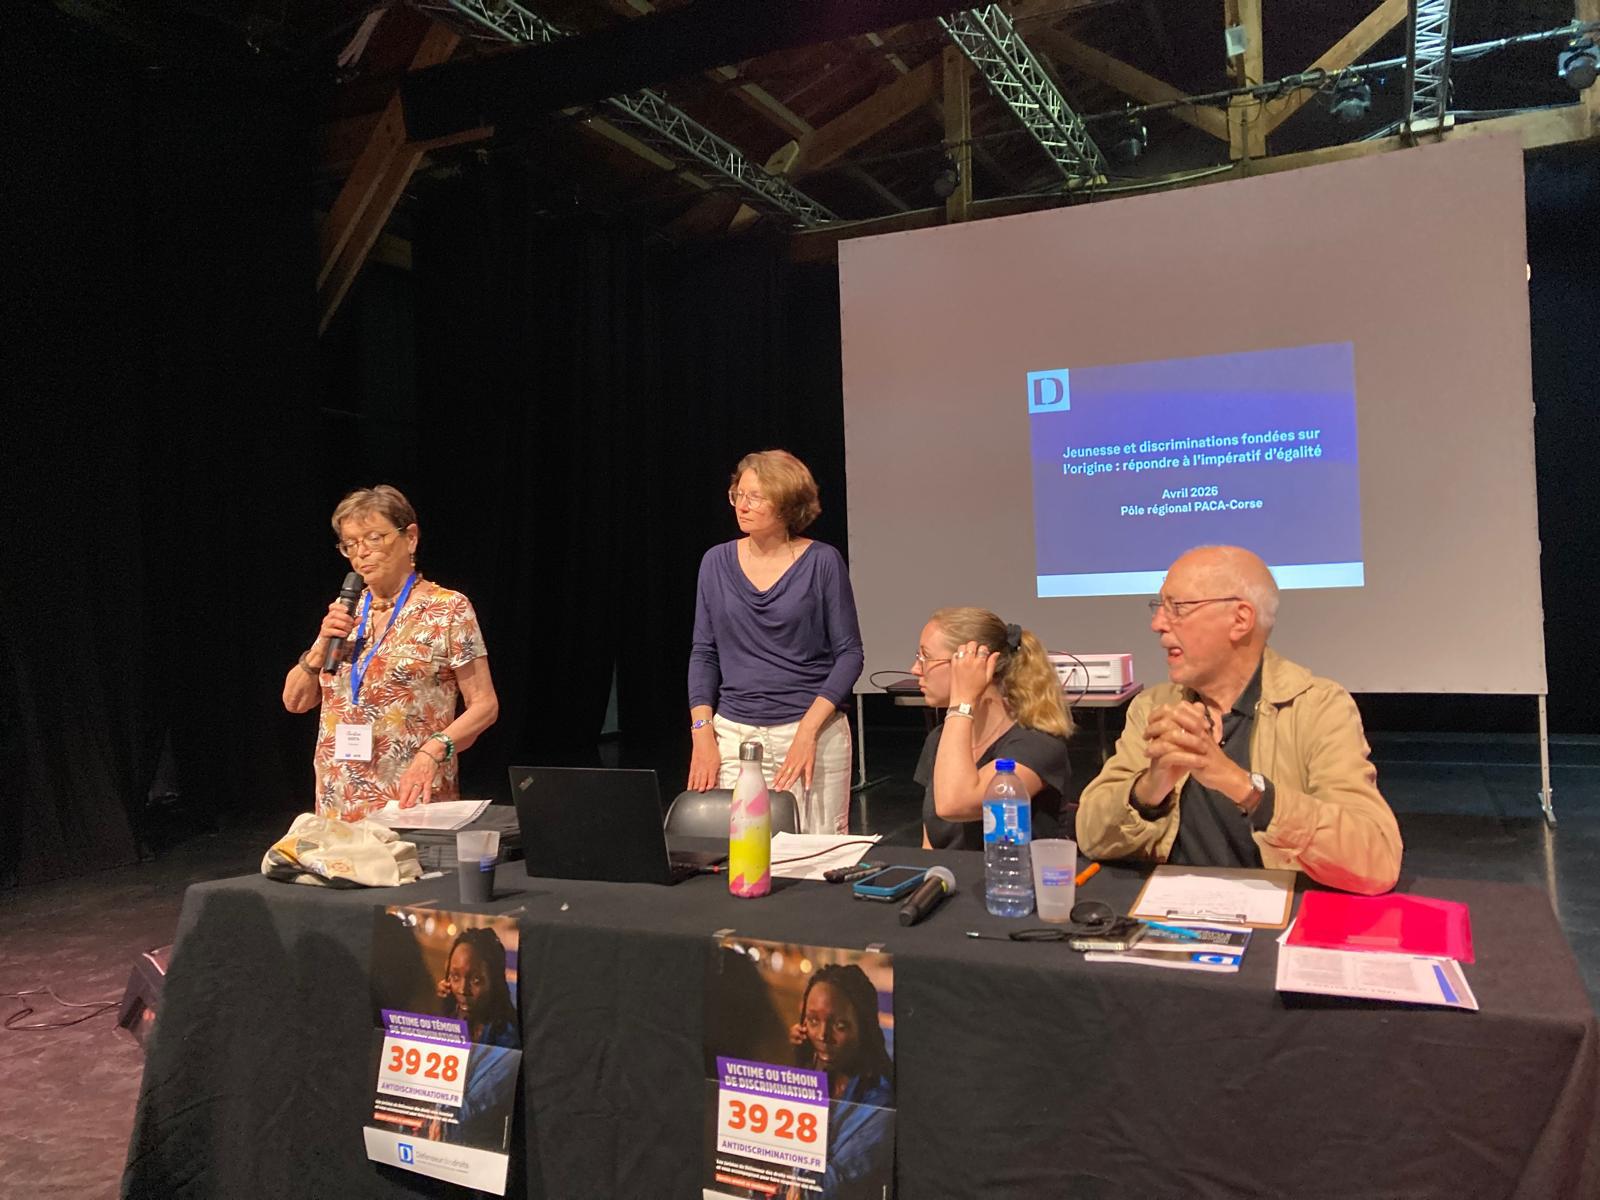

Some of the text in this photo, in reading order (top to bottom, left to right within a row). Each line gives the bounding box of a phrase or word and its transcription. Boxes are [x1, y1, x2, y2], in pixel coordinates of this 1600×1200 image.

[1033, 377, 1064, 406] D
[1063, 430, 1321, 458] Jeunesse et discriminations fondées sur
[1122, 457, 1180, 472] répondre
[1182, 455, 1190, 466] à
[1193, 449, 1262, 467] l'impératif
[1162, 486, 1218, 499] Avril 2026
[1120, 499, 1263, 516] Pôle régional PACA-Corse
[388, 1014, 420, 1027] VICTIME
[431, 1019, 461, 1034] TÉMOIN
[388, 1046, 459, 1082] 39 28
[726, 1063, 818, 1088] VICTIME OU TÉMOIN
[381, 1082, 460, 1103] ANTIDISCRIMINATIONS.FR
[725, 1075, 737, 1087] DE
[738, 1077, 817, 1100] DISCRIMINATION
[728, 1100, 817, 1143] 39 28
[722, 1140, 822, 1167] ANTIDISCRIMINATIONS.FR
